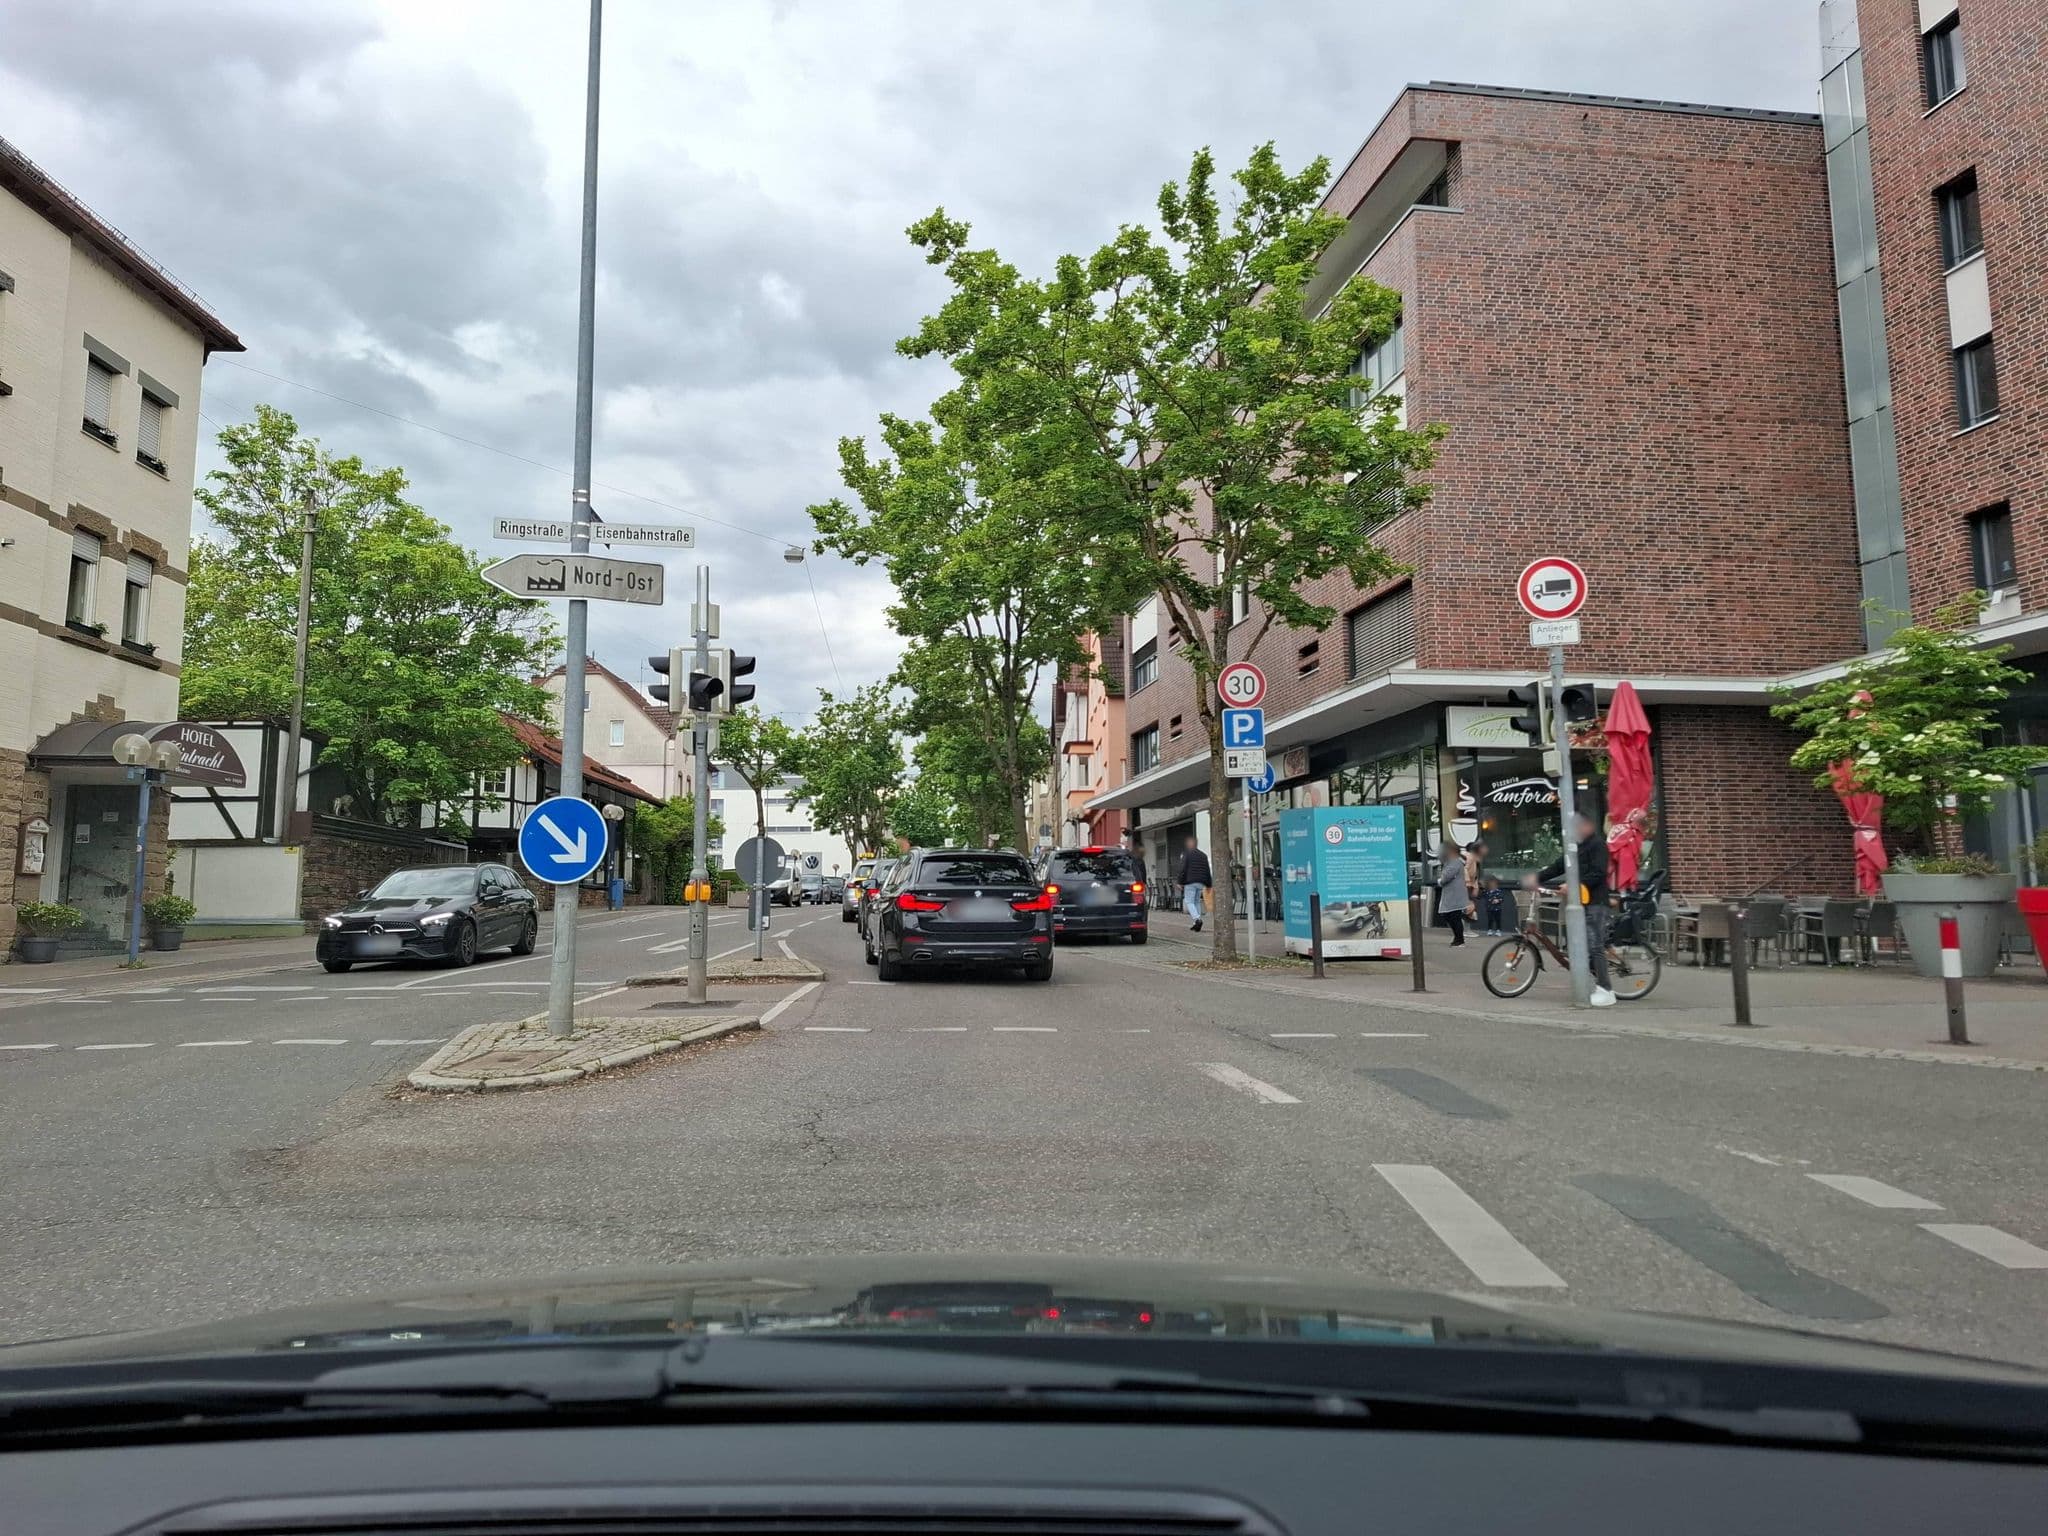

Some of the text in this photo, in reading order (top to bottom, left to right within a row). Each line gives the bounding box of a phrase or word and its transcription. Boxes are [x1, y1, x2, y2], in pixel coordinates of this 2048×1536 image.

[500, 521, 564, 537] Ringstraße
[596, 526, 690, 542] Eisenbahnstraße
[574, 566, 654, 591] Nord-Ost
[1536, 624, 1573, 634] Anlieger
[1229, 676, 1255, 695] 30
[181, 728, 216, 748] HOTEL
[1233, 714, 1255, 743] P
[171, 740, 225, 768] ntracht
[1491, 777, 1519, 789] Pizzeria
[1493, 787, 1554, 808] amfora
[1328, 830, 1340, 840] 30
